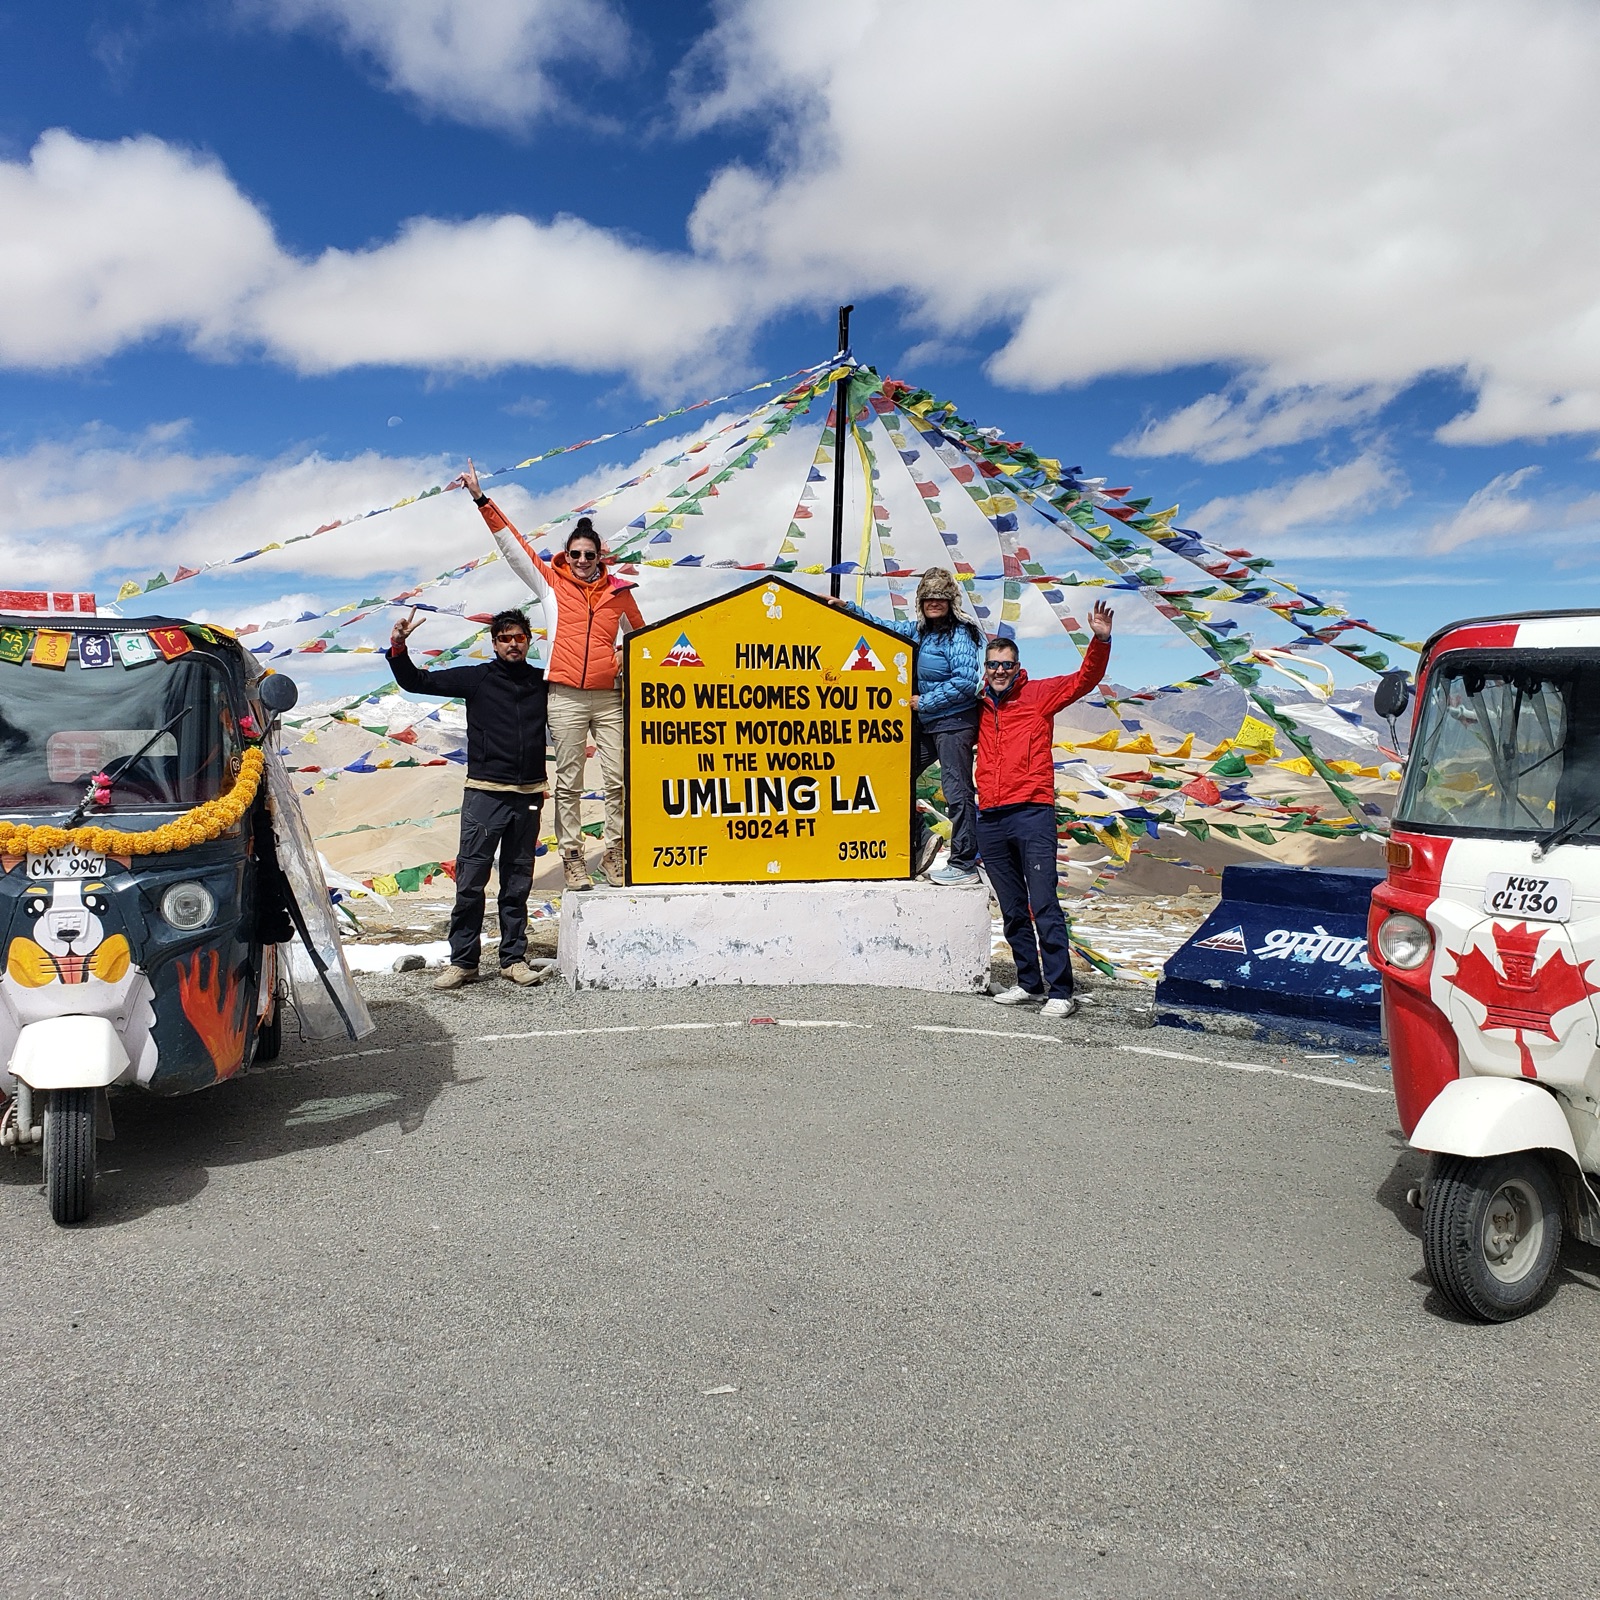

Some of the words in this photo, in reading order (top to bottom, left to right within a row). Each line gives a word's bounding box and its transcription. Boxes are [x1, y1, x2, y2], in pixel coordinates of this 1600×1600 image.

[735, 643, 822, 671] HIMANK
[641, 682, 686, 709] BRO
[693, 683, 810, 710] WELCOMES
[816, 685, 858, 711] YOU
[866, 686, 893, 709] TO
[641, 720, 727, 745] HIGHEST
[735, 719, 852, 746] MOTORABLE
[858, 719, 904, 745] PASS
[697, 753, 715, 772] IN
[723, 753, 758, 771] THE
[766, 752, 835, 771] WORLD
[662, 775, 820, 818] UMLING
[830, 775, 880, 815] LA
[726, 819, 789, 840] 19024
[795, 818, 816, 837] FT
[69, 858, 104, 877] 9967
[652, 846, 708, 868] 753TF
[838, 840, 887, 861] 93RCC
